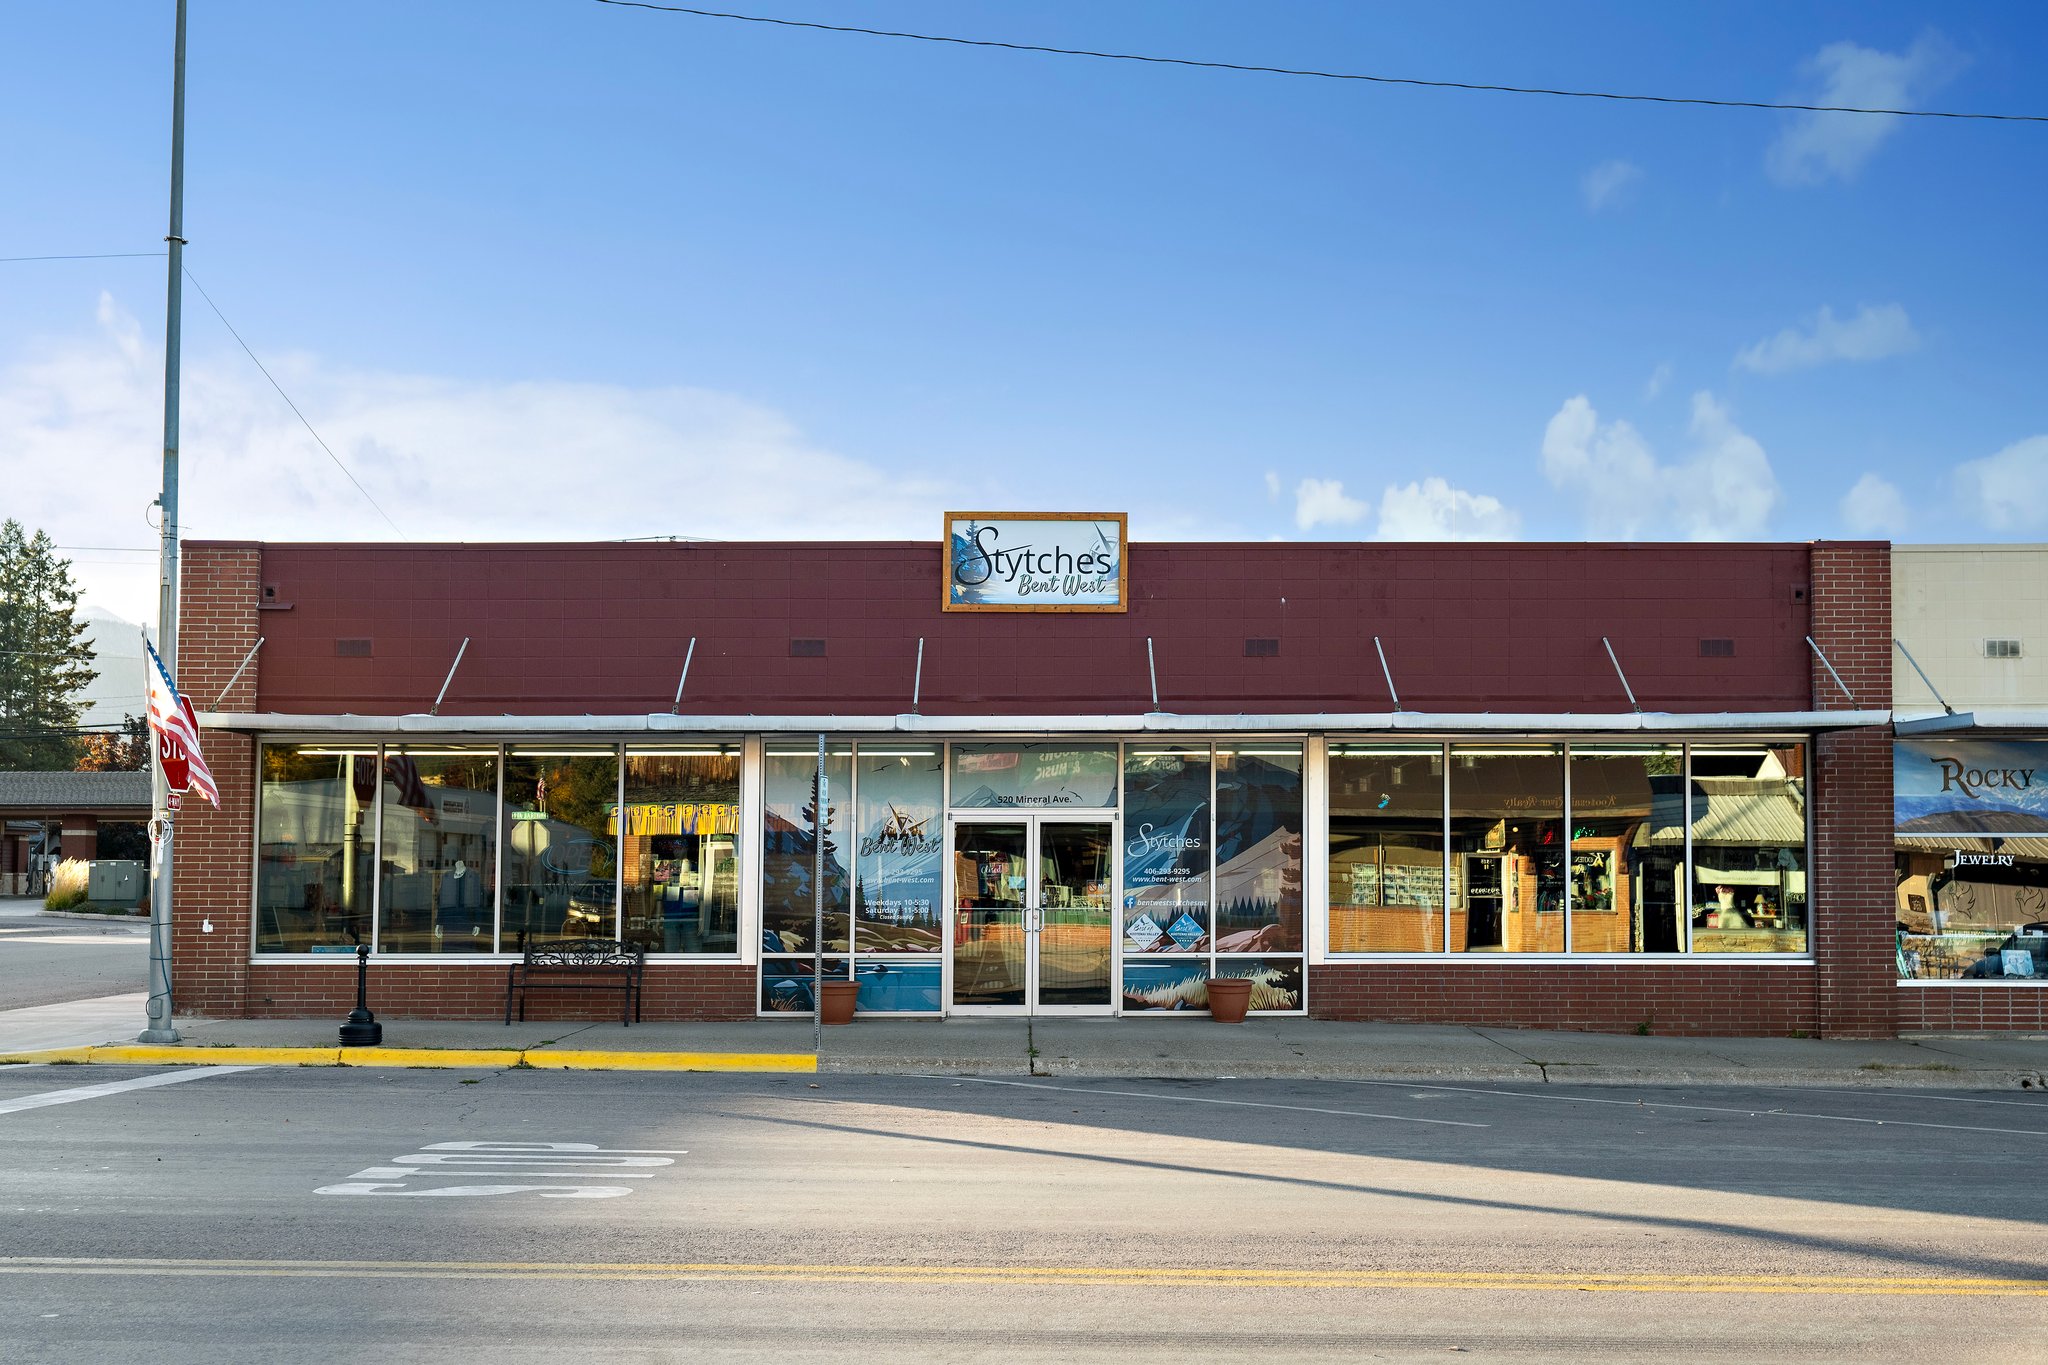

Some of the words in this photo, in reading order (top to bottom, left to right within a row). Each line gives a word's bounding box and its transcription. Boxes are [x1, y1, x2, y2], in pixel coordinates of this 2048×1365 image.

[954, 526, 1111, 586] Stytches
[1018, 574, 1060, 596] Bent
[1062, 574, 1107, 596] West
[161, 734, 187, 760] ST
[997, 795, 1013, 804] 520
[1016, 795, 1050, 804] Mineral
[1052, 795, 1072, 804] Ave.
[860, 837, 898, 857] Bent
[900, 837, 940, 857] West
[1127, 822, 1201, 858] Stytches
[864, 899, 902, 908] Weekdays
[865, 907, 898, 915] Saturday
